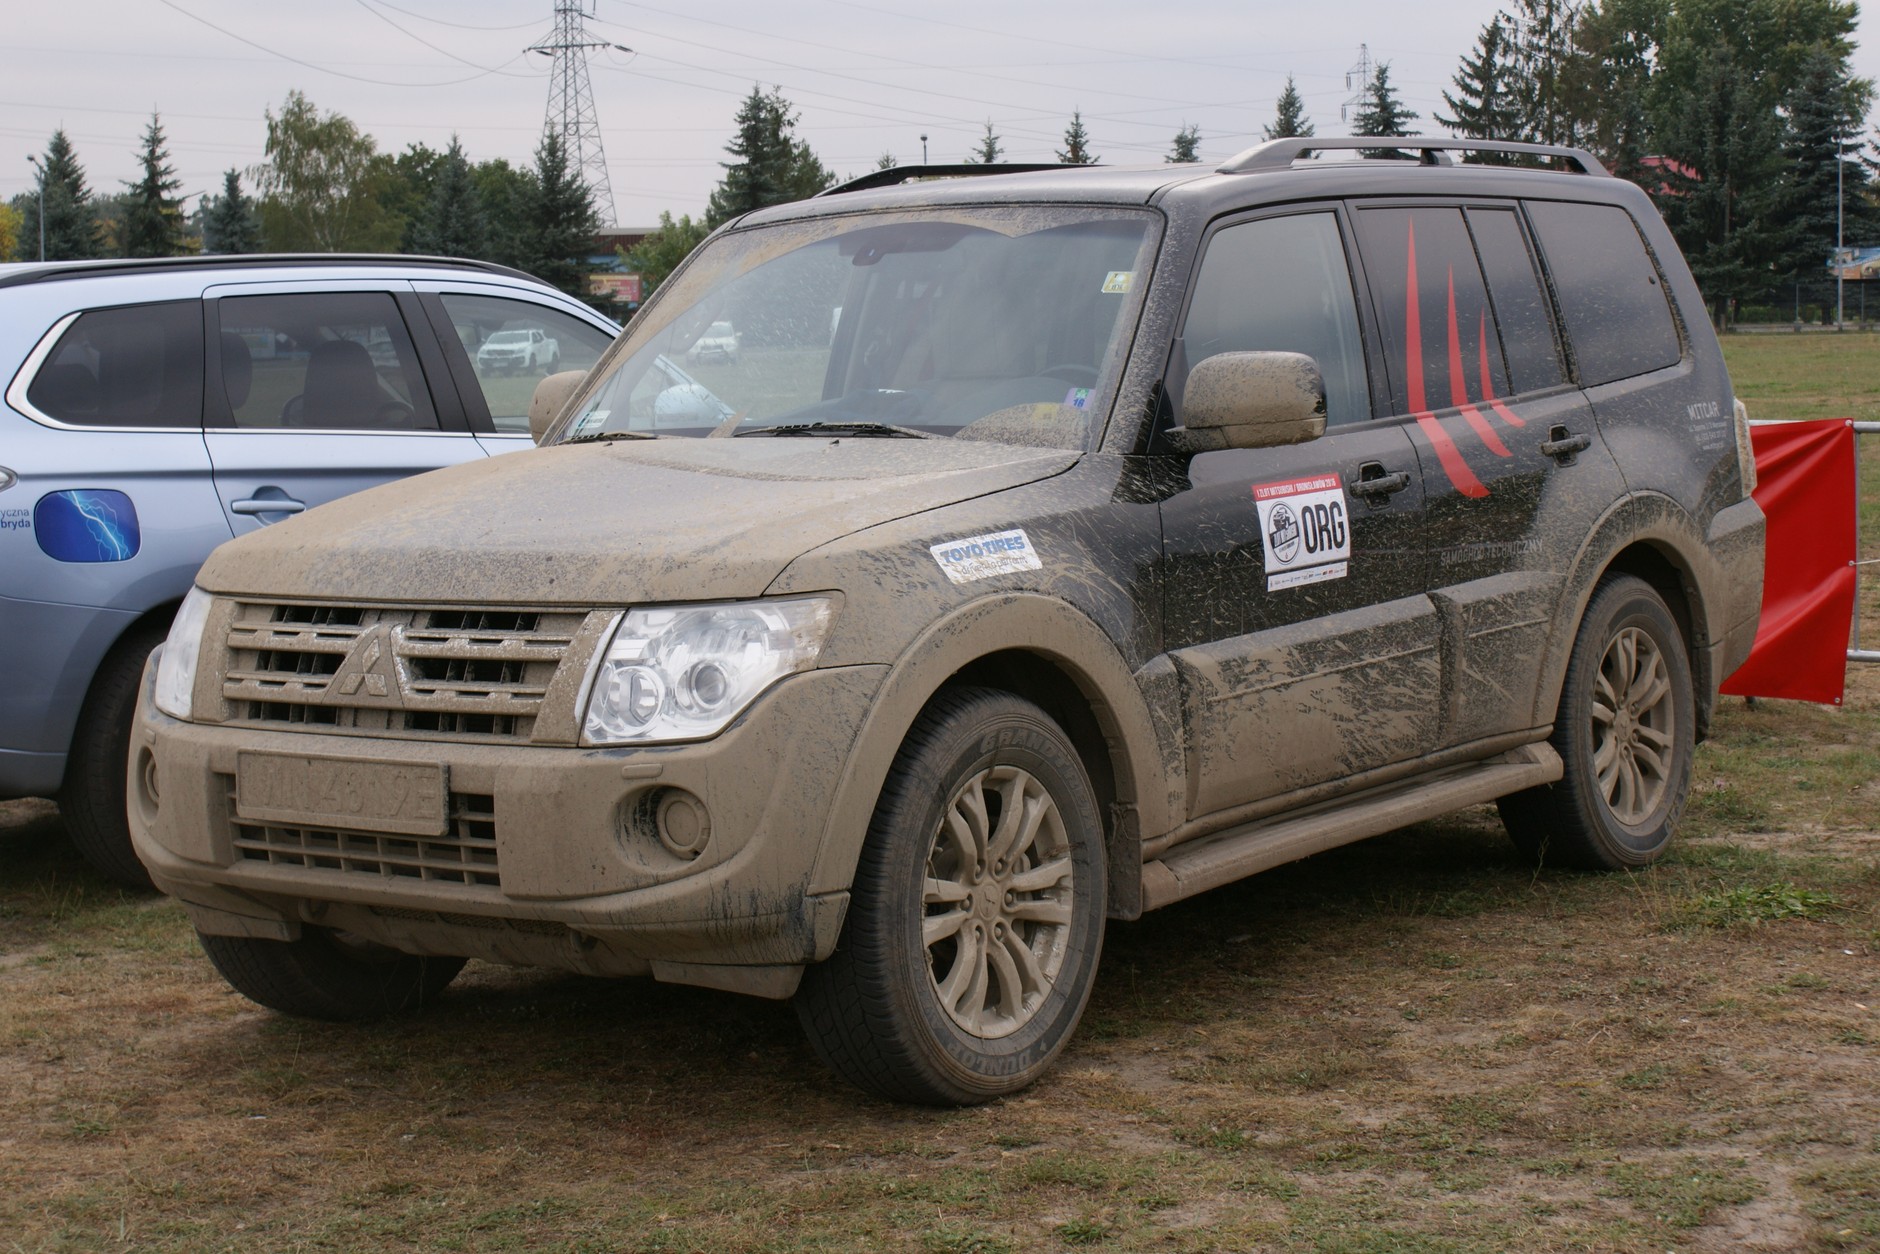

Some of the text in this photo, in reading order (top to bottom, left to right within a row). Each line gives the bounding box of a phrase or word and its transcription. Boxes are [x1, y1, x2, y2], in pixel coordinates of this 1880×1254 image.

[1687, 401, 1720, 420] MITCAR
[0, 509, 30, 520] yczna
[0, 518, 31, 531] bryda
[1301, 501, 1345, 554] ORG
[939, 536, 1025, 563] TOYO TIRES
[947, 1043, 1032, 1076] DUNLOP
